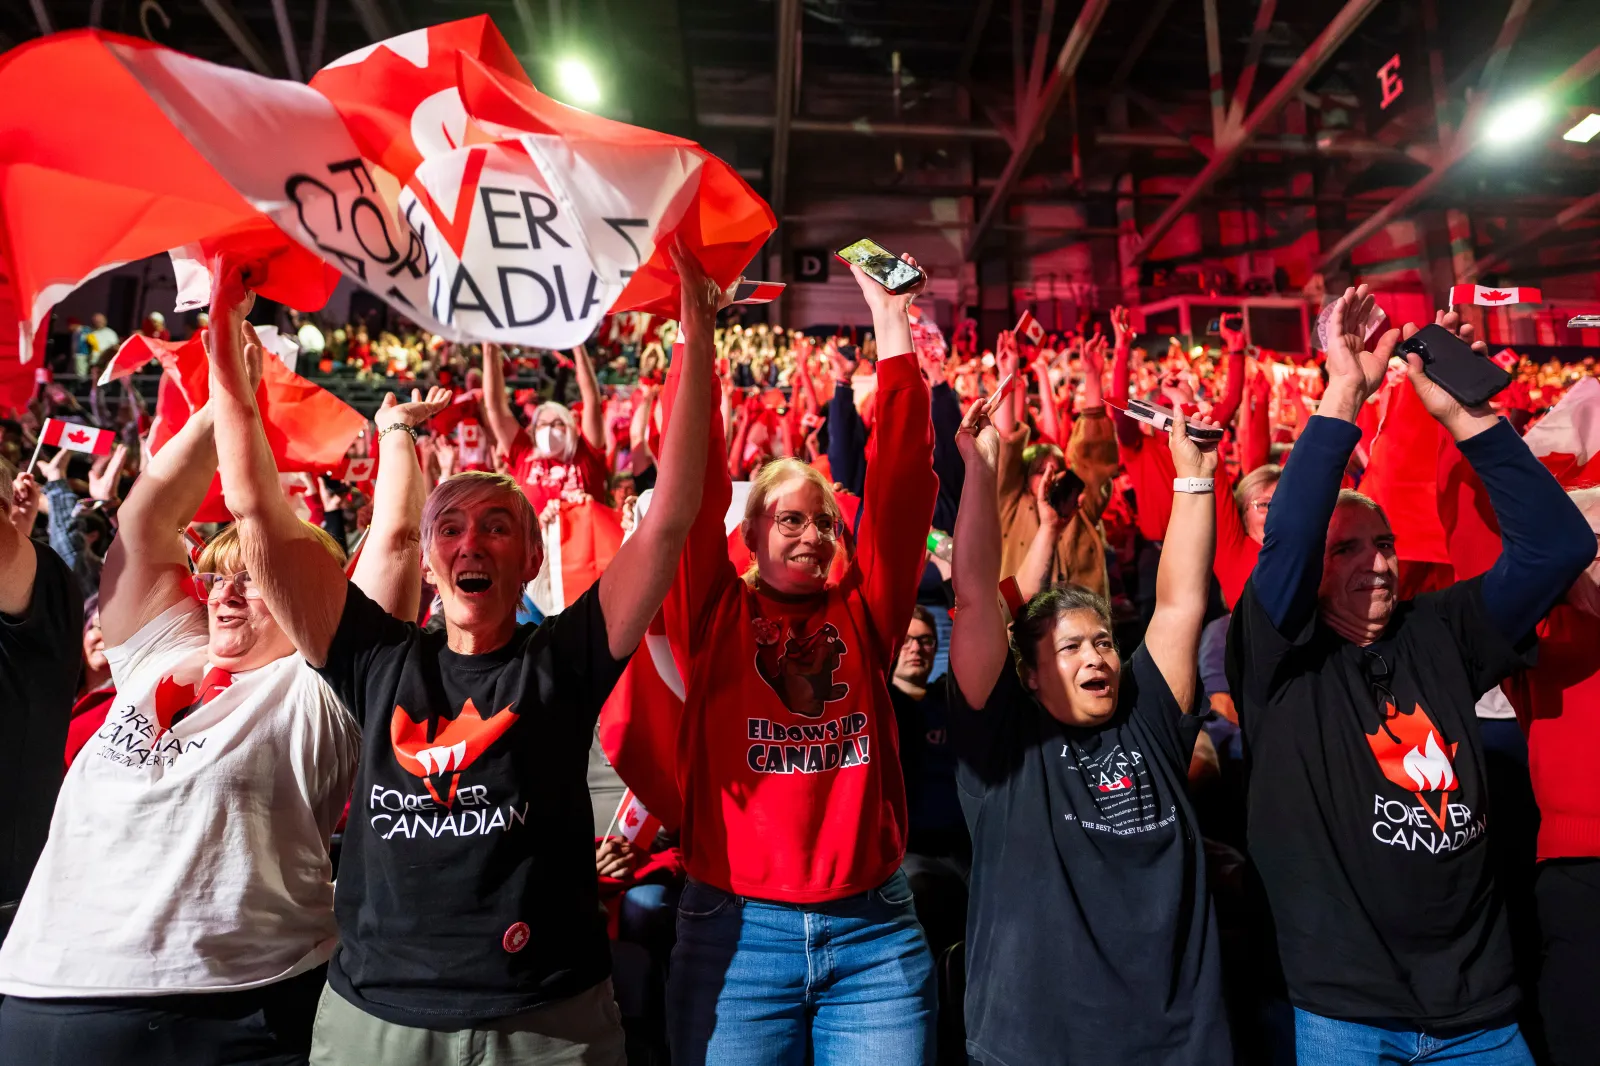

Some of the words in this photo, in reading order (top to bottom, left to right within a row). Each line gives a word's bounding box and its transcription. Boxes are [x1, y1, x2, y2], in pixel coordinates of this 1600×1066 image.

[1376, 53, 1404, 110] E
[802, 256, 821, 275] D
[98, 721, 207, 764] CANAIAN
[747, 717, 840, 742] ELBOWS
[839, 711, 868, 737] UP
[746, 735, 871, 774] CANADA!
[370, 773, 492, 812] FOREVER
[1374, 791, 1471, 833] FOREVER
[370, 801, 529, 840] CANADIAN
[1081, 820, 1095, 829] THE
[1095, 823, 1112, 832] BEST
[1372, 813, 1487, 854] CANADIAN
